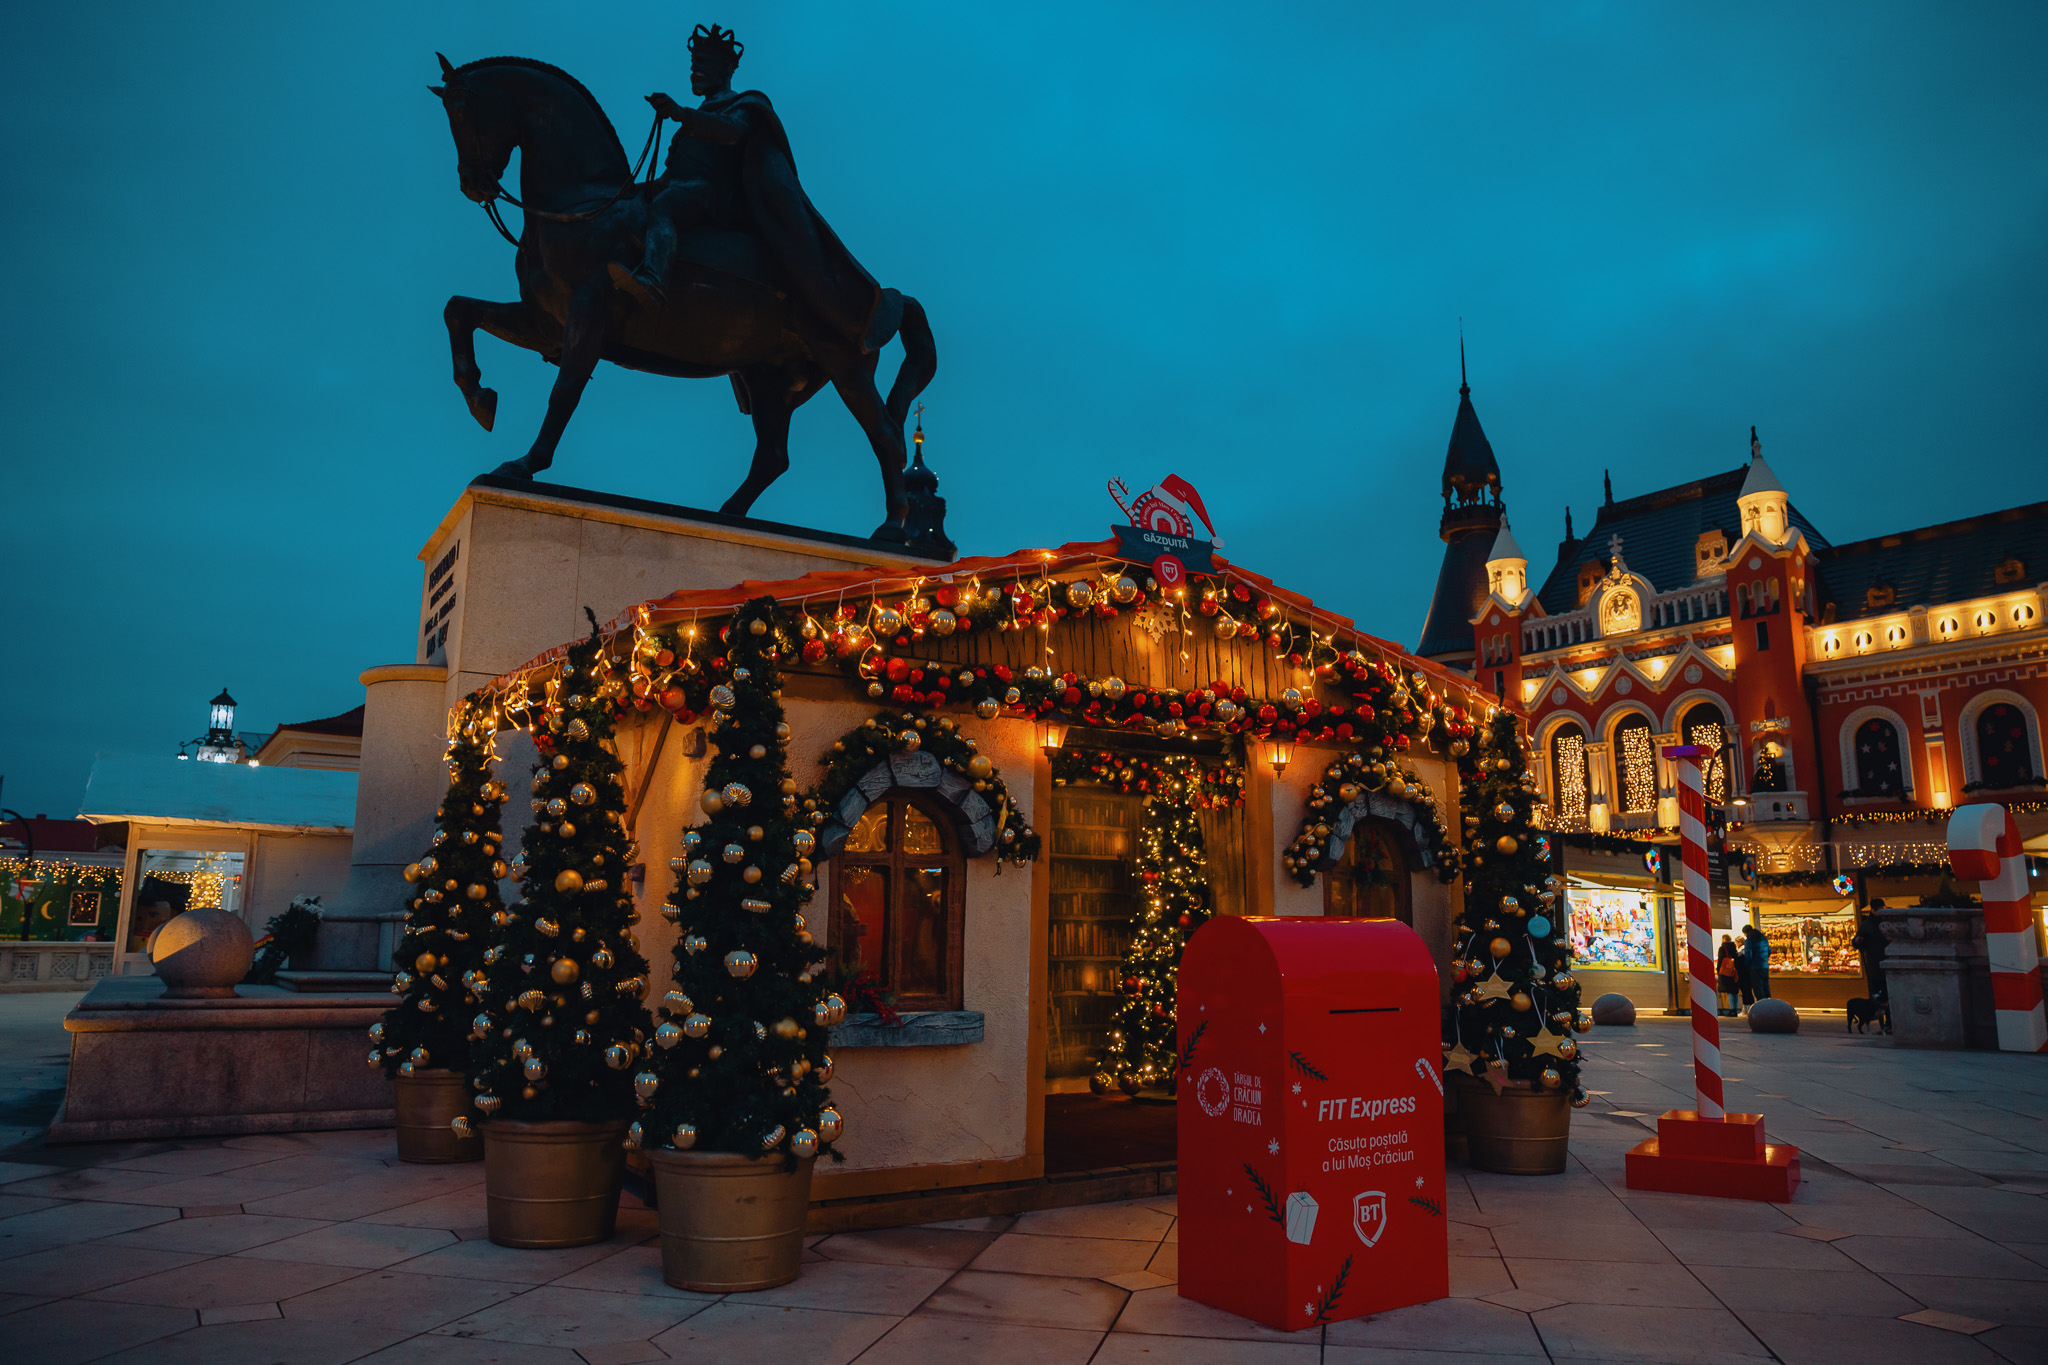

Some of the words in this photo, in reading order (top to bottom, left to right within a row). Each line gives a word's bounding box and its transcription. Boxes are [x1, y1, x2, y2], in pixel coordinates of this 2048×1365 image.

[1143, 533, 1188, 549] GĂZDUITĂ
[1165, 566, 1174, 574] BT
[1254, 1075, 1262, 1088] DE
[1233, 1086, 1262, 1105] CRĂCIUN
[1233, 1107, 1262, 1126] ORADEA
[1318, 1098, 1347, 1121] FIT
[1350, 1096, 1416, 1121] Express
[1328, 1137, 1367, 1153] Căsuța
[1369, 1130, 1408, 1150] poștală
[1322, 1160, 1330, 1172] a
[1332, 1155, 1346, 1171] lui
[1348, 1154, 1371, 1171] Moș
[1373, 1149, 1414, 1166] Crăciun
[1360, 1203, 1380, 1223] BT
